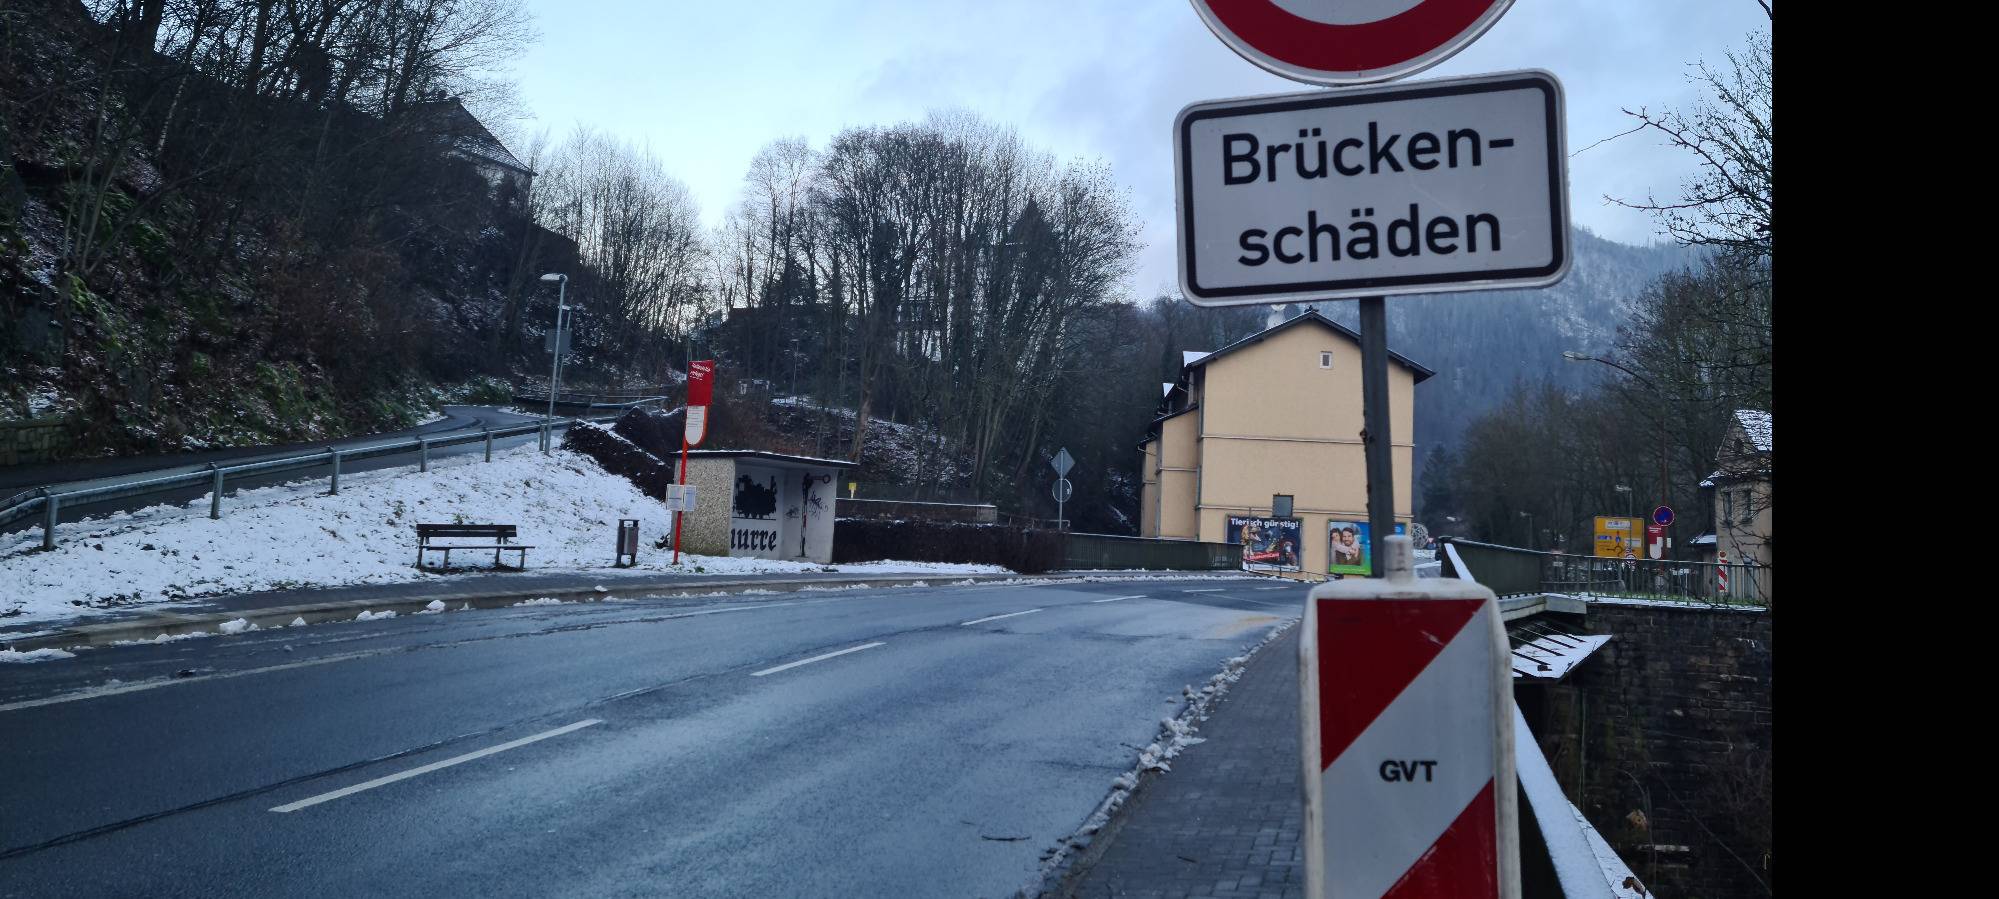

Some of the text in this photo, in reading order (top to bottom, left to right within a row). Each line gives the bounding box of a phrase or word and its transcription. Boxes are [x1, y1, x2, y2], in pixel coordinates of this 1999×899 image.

[1222, 121, 1515, 186] Brücken-
[1237, 203, 1502, 267] schäden
[1379, 760, 1438, 782] GVT
